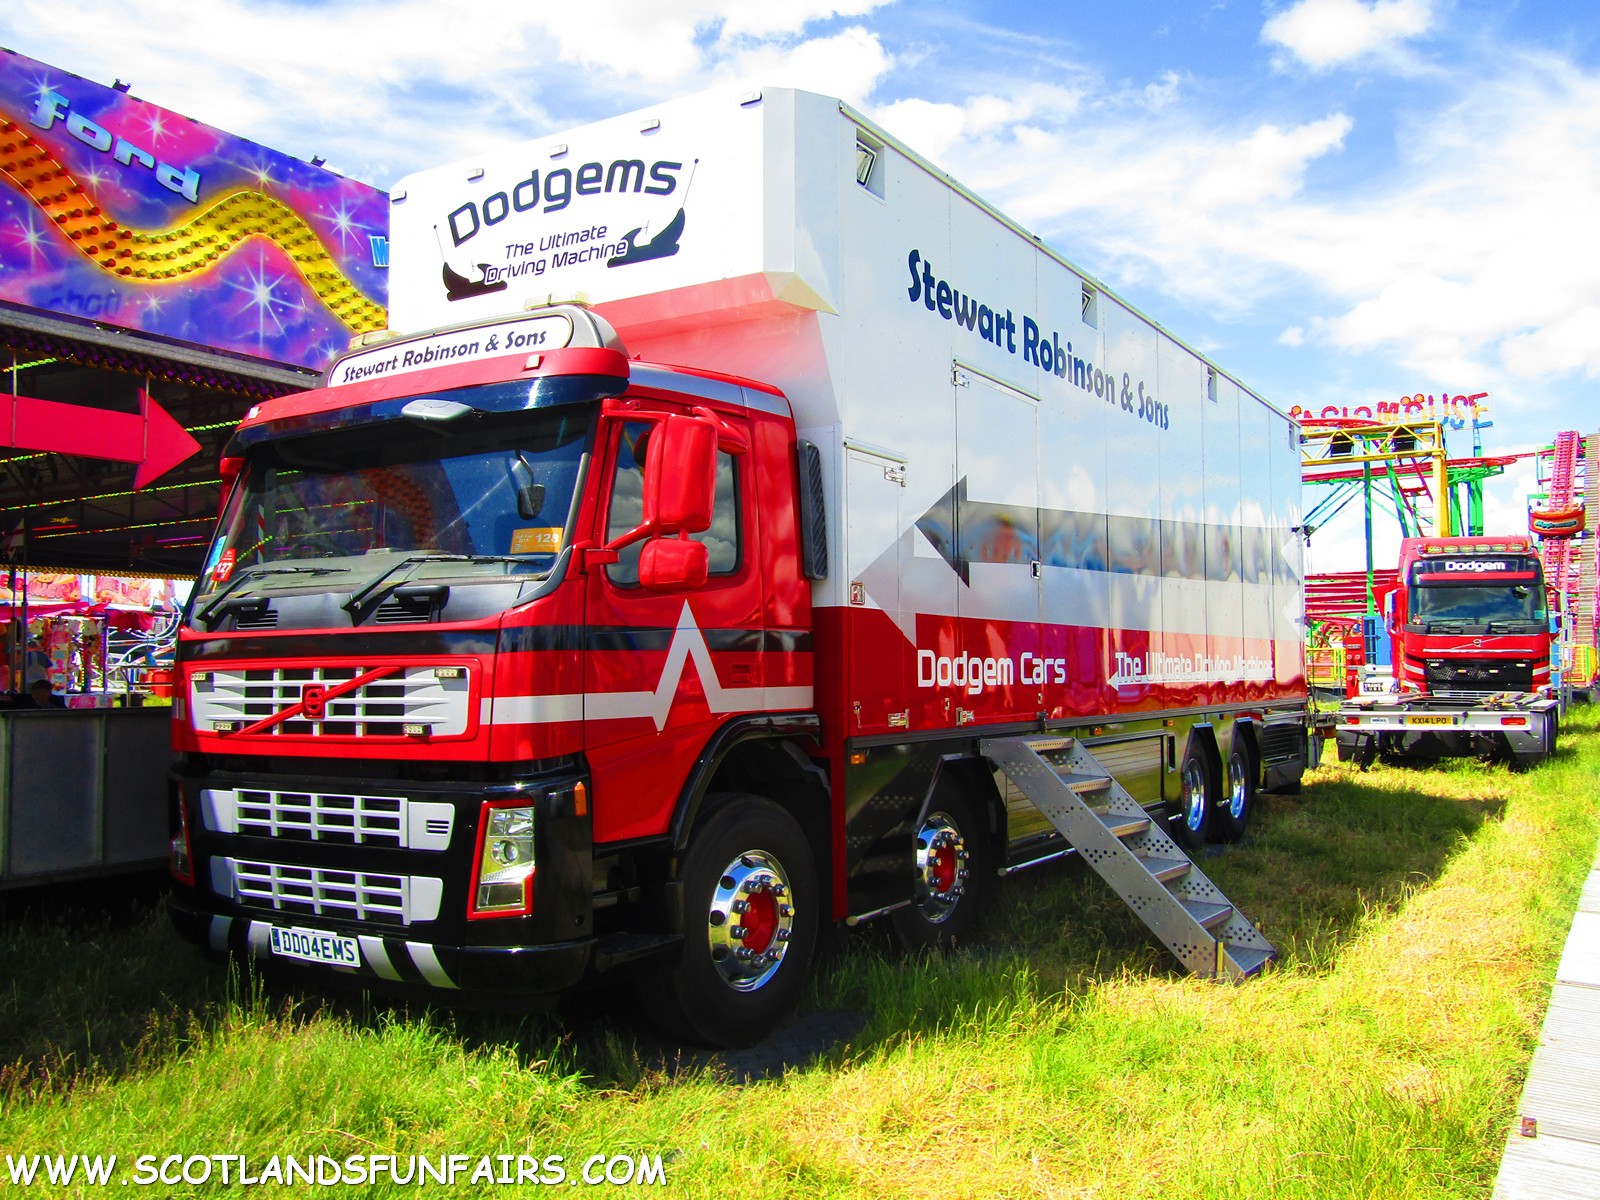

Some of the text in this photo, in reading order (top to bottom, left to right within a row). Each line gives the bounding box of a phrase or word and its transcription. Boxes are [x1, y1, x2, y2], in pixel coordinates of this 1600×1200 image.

[29, 89, 202, 204] ford
[446, 157, 683, 248] Dodgems
[486, 241, 627, 283] Driving Machine
[505, 225, 607, 259] The Ultimate
[343, 330, 547, 383] Stewart Robinson & Sons
[908, 248, 1169, 431] Stewart Robinson & Sons
[536, 533, 559, 543] 128
[216, 562, 233, 573] 127
[1445, 561, 1506, 573] Dodgem
[917, 649, 1066, 695] Dodgem Cars
[1115, 652, 1141, 683] The
[1146, 652, 1192, 681] Ultimate
